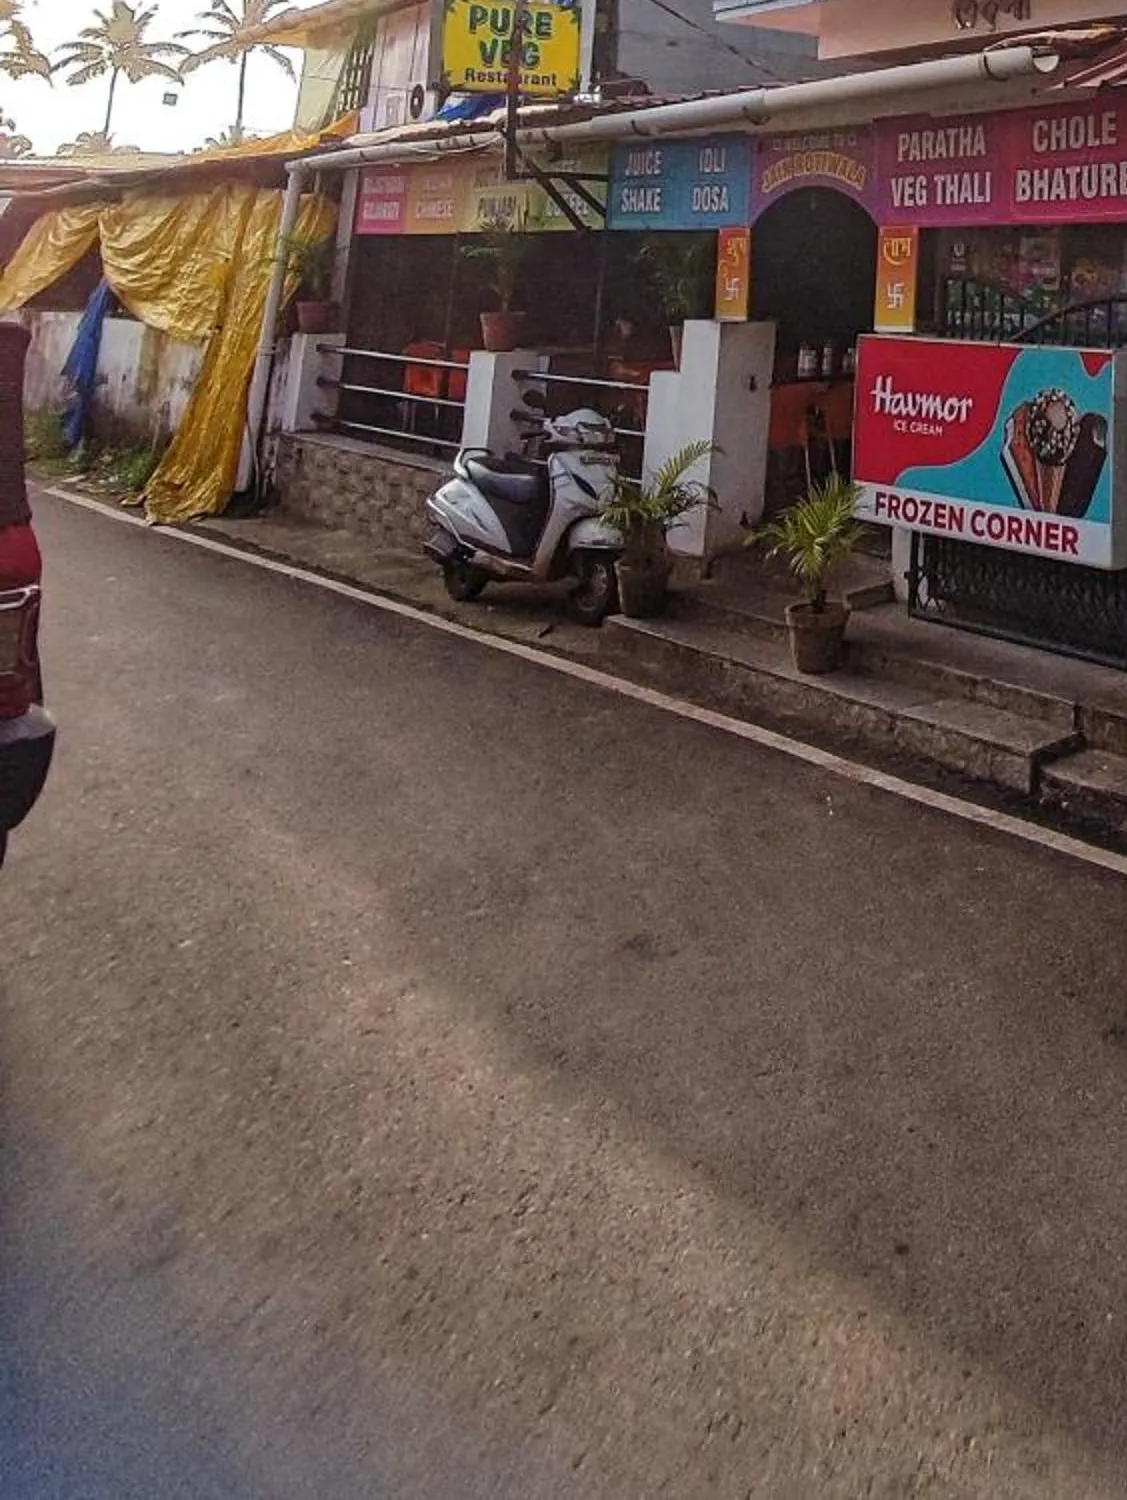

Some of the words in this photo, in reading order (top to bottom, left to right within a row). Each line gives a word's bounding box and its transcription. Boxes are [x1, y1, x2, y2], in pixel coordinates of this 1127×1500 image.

[469, 4, 553, 39] PURE
[479, 38, 540, 69] VEG
[464, 67, 557, 87] Restrant
[897, 125, 986, 162] PARATHA
[1032, 111, 1117, 153] CHOLE
[625, 151, 663, 176] JUICE
[699, 148, 725, 173] IDLI
[621, 187, 662, 213] SHAKE
[692, 184, 730, 212] DOSA
[891, 174, 927, 208] VEG
[934, 171, 992, 205] THALI
[871, 375, 973, 424] Havmor
[893, 420, 907, 434] ICE
[909, 422, 943, 437] CREAM
[874, 491, 964, 533] FROZEN
[970, 509, 1080, 556] CORNER
